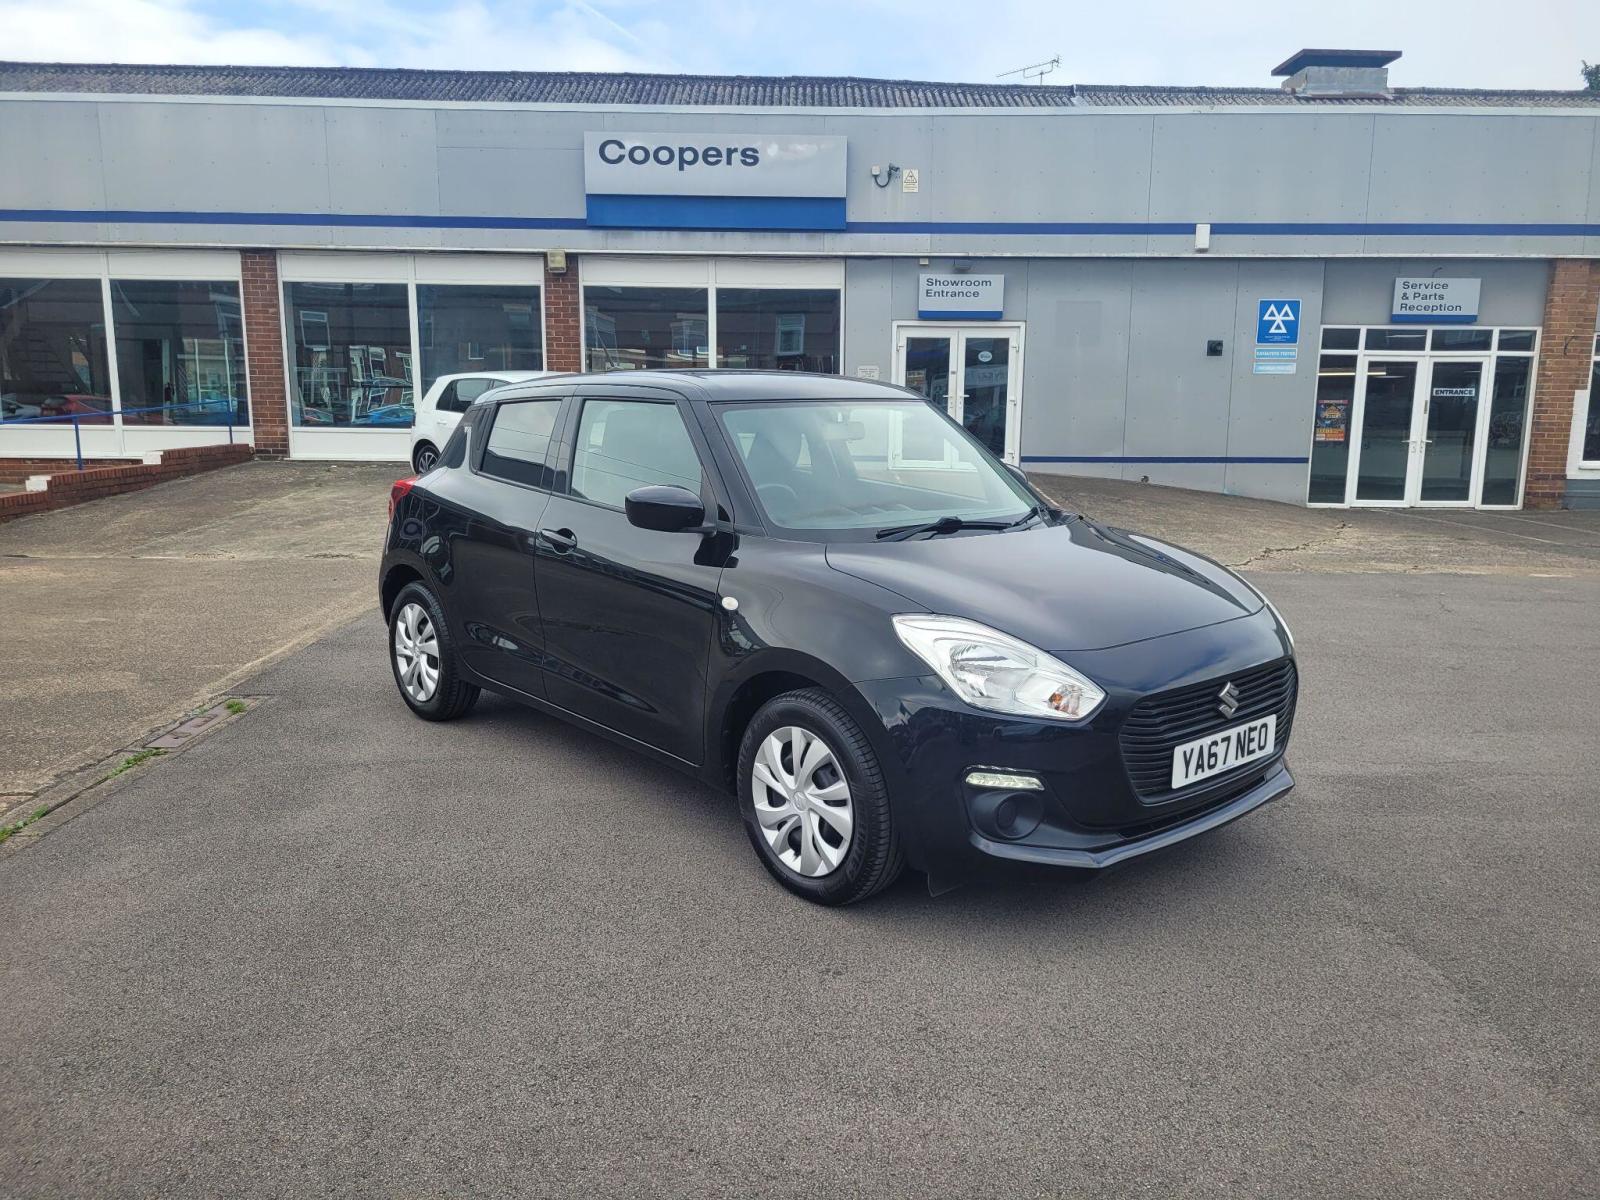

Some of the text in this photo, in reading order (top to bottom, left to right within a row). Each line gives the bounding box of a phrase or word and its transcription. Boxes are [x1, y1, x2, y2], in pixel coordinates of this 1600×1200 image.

[599, 139, 760, 171] Coopers
[926, 278, 992, 287] Showroom
[1402, 281, 1449, 290] Service
[925, 289, 980, 298] Entrance
[1401, 292, 1445, 301] & Parts
[1400, 303, 1462, 313] Reception
[1183, 722, 1268, 779] YA67 NEO
